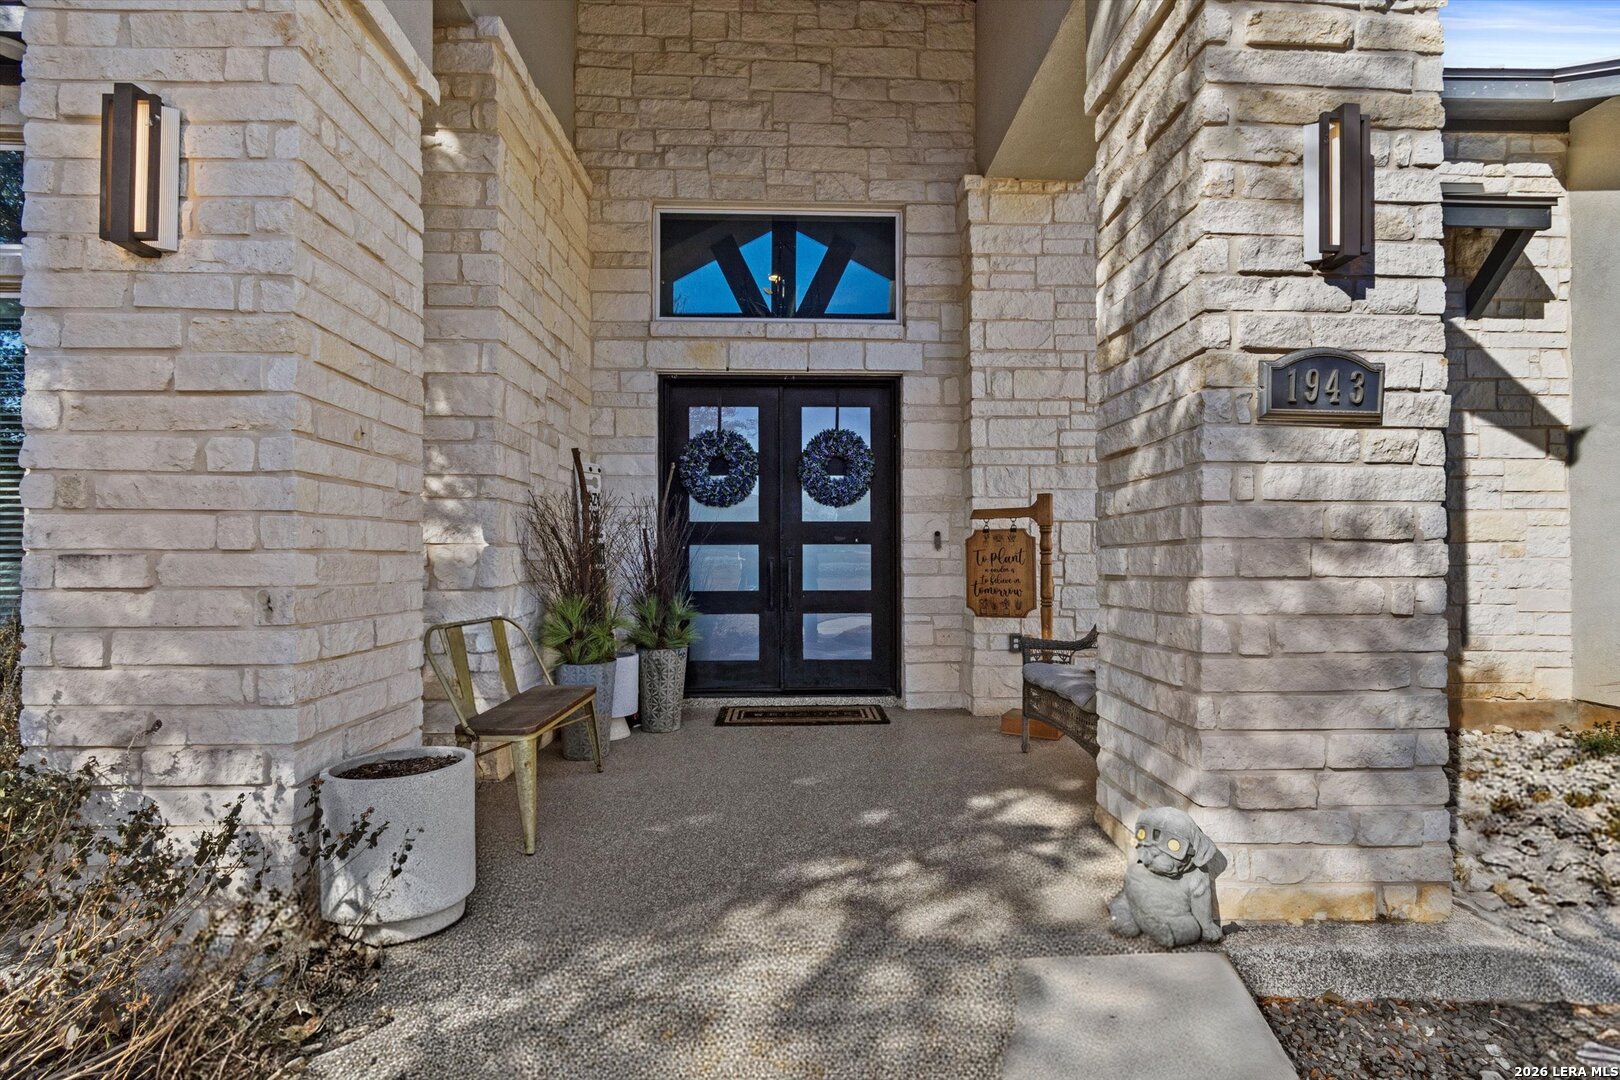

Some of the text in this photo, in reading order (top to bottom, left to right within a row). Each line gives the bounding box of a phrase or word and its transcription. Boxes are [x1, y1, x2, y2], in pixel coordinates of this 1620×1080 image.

[1287, 368, 1365, 405] 1943
[973, 547, 1026, 567] To plant
[970, 580, 1023, 597] tomorrow
